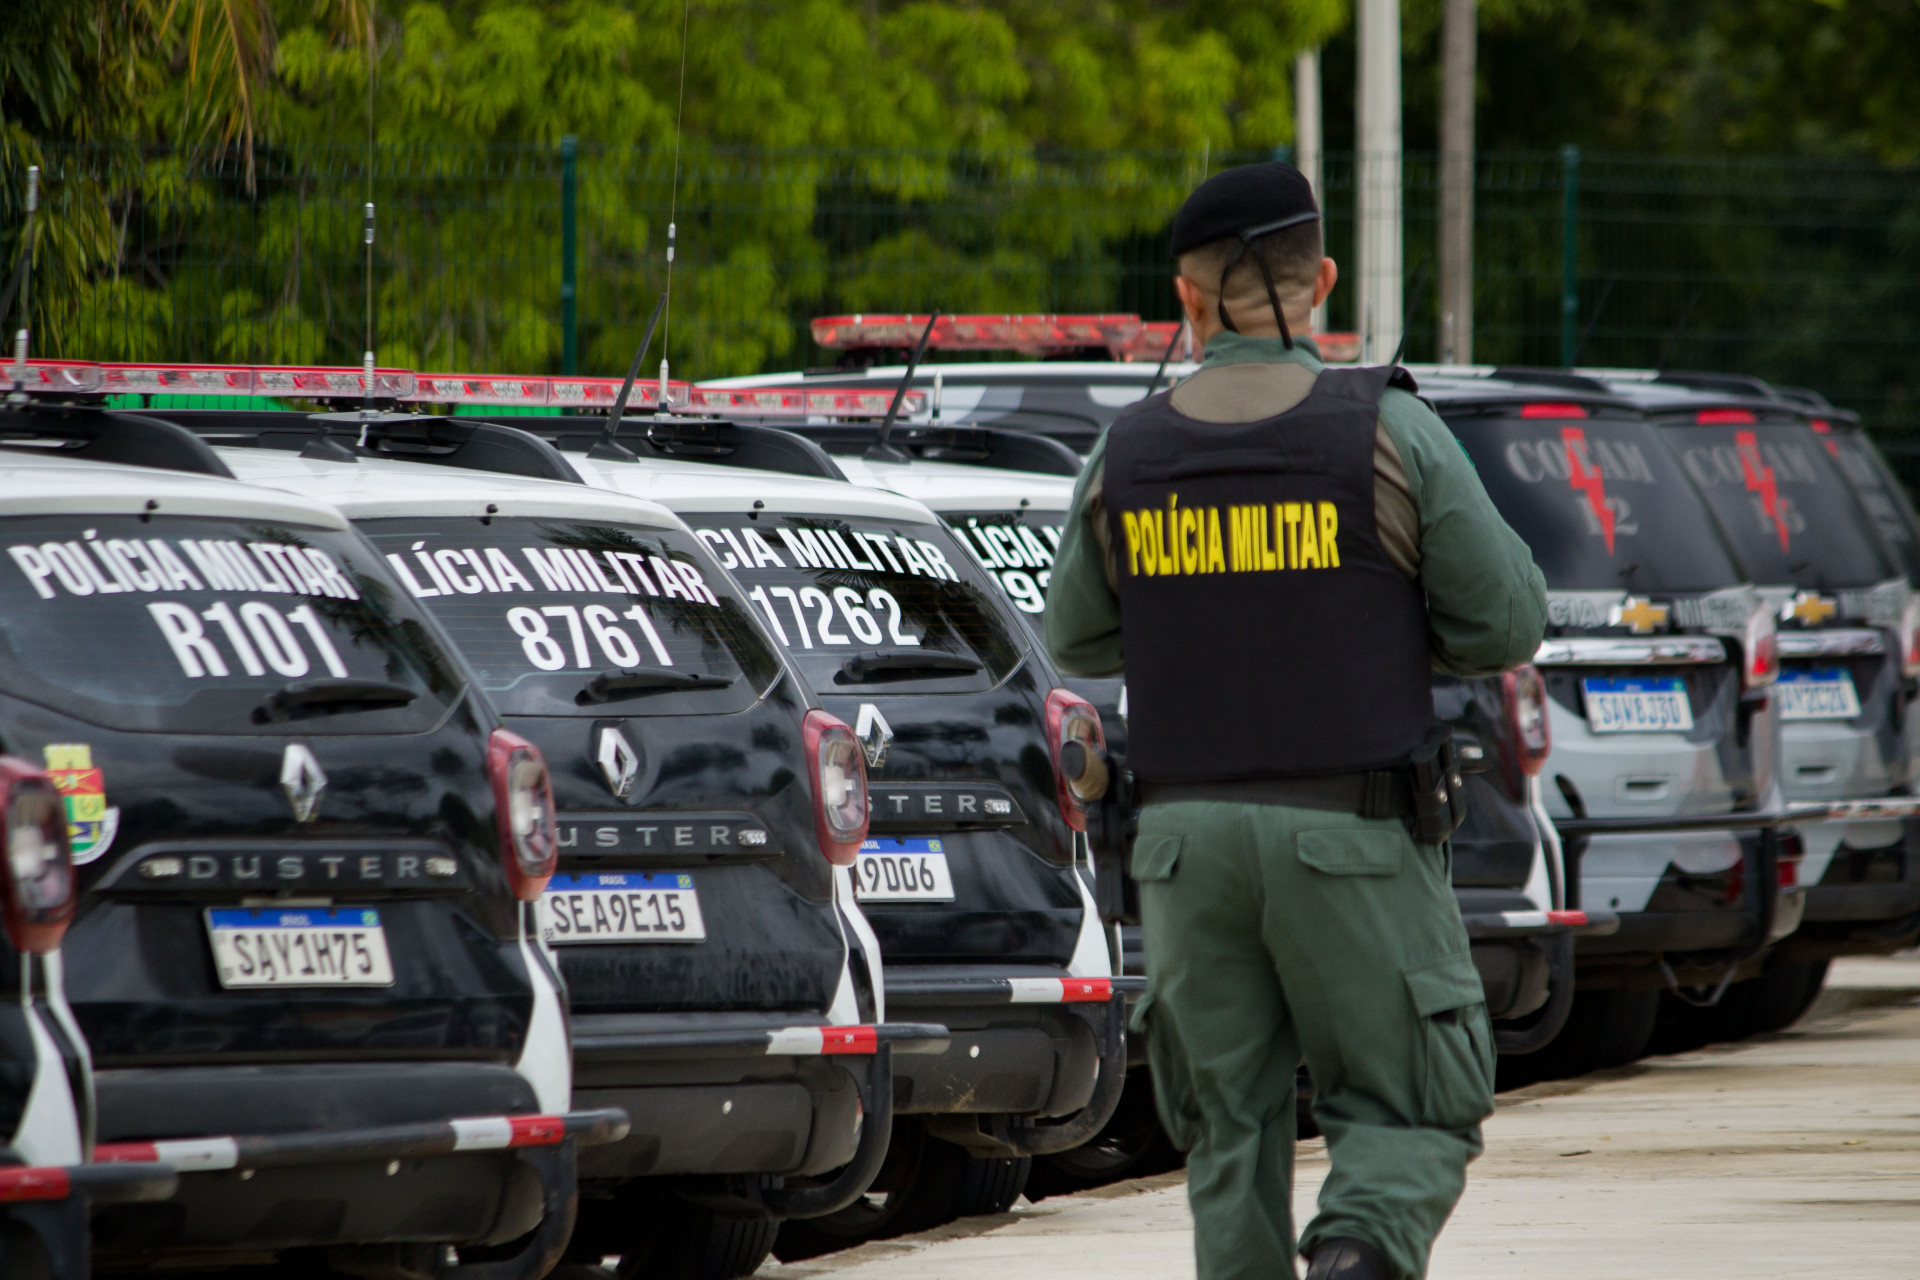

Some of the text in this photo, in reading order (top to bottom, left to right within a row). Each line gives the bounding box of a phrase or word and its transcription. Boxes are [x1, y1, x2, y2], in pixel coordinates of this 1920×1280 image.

[7, 529, 361, 601] POLÍCIA MILITAR
[695, 526, 961, 583] CIA MILITAR
[1121, 492, 1341, 577] POLÍCIA MILITAR
[386, 541, 721, 608] LÍCIA MILITAR
[146, 601, 349, 678] R101
[506, 604, 674, 671] 8761
[750, 585, 921, 649] 17262
[188, 856, 420, 879] DUSTER
[551, 893, 686, 934] SEA9E15
[233, 932, 373, 978] SAY1H75
